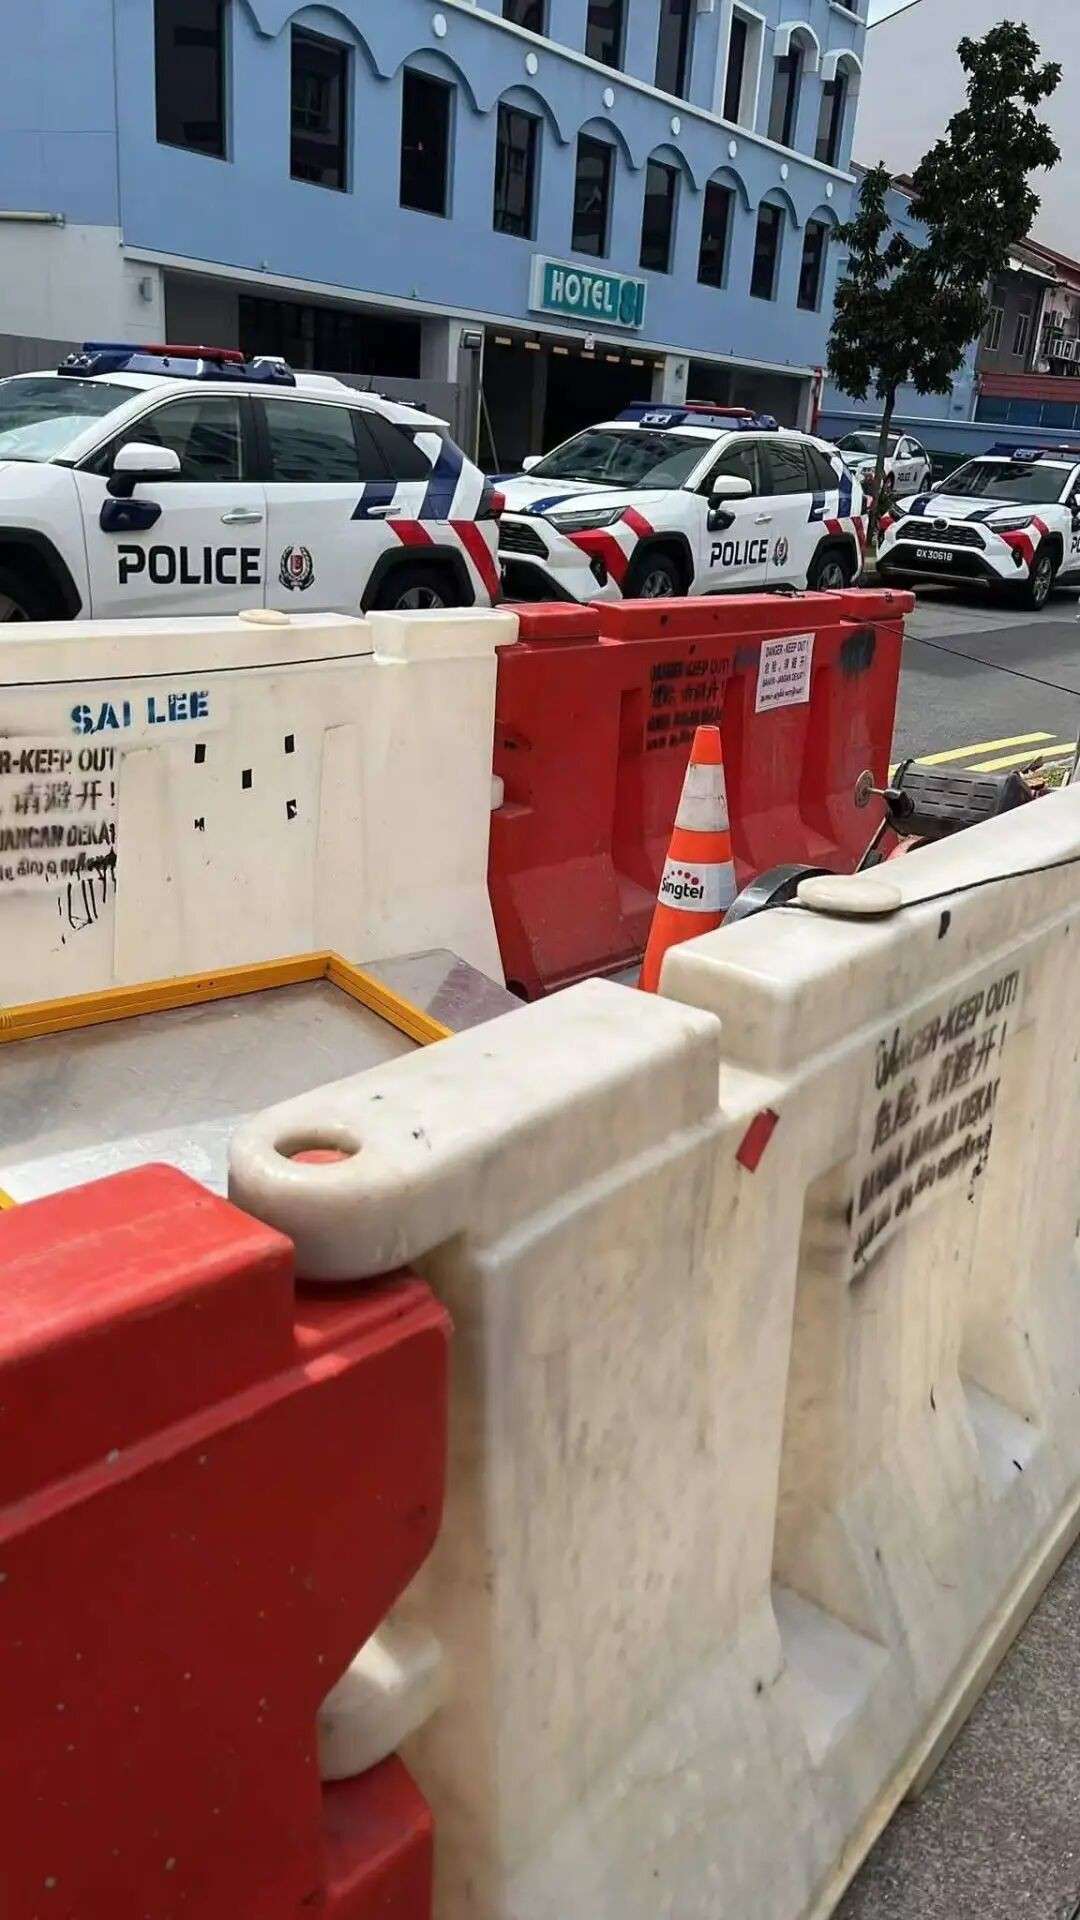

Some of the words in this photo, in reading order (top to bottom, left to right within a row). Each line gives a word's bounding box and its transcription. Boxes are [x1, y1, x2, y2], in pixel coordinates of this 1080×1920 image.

[551, 270, 613, 312] HOTEL
[619, 280, 645, 326] 81
[117, 545, 261, 584] POLICE
[710, 539, 769, 567] POLICE
[71, 702, 131, 735] SAI
[147, 691, 208, 724] LEE
[661, 877, 705, 899] Singtel
